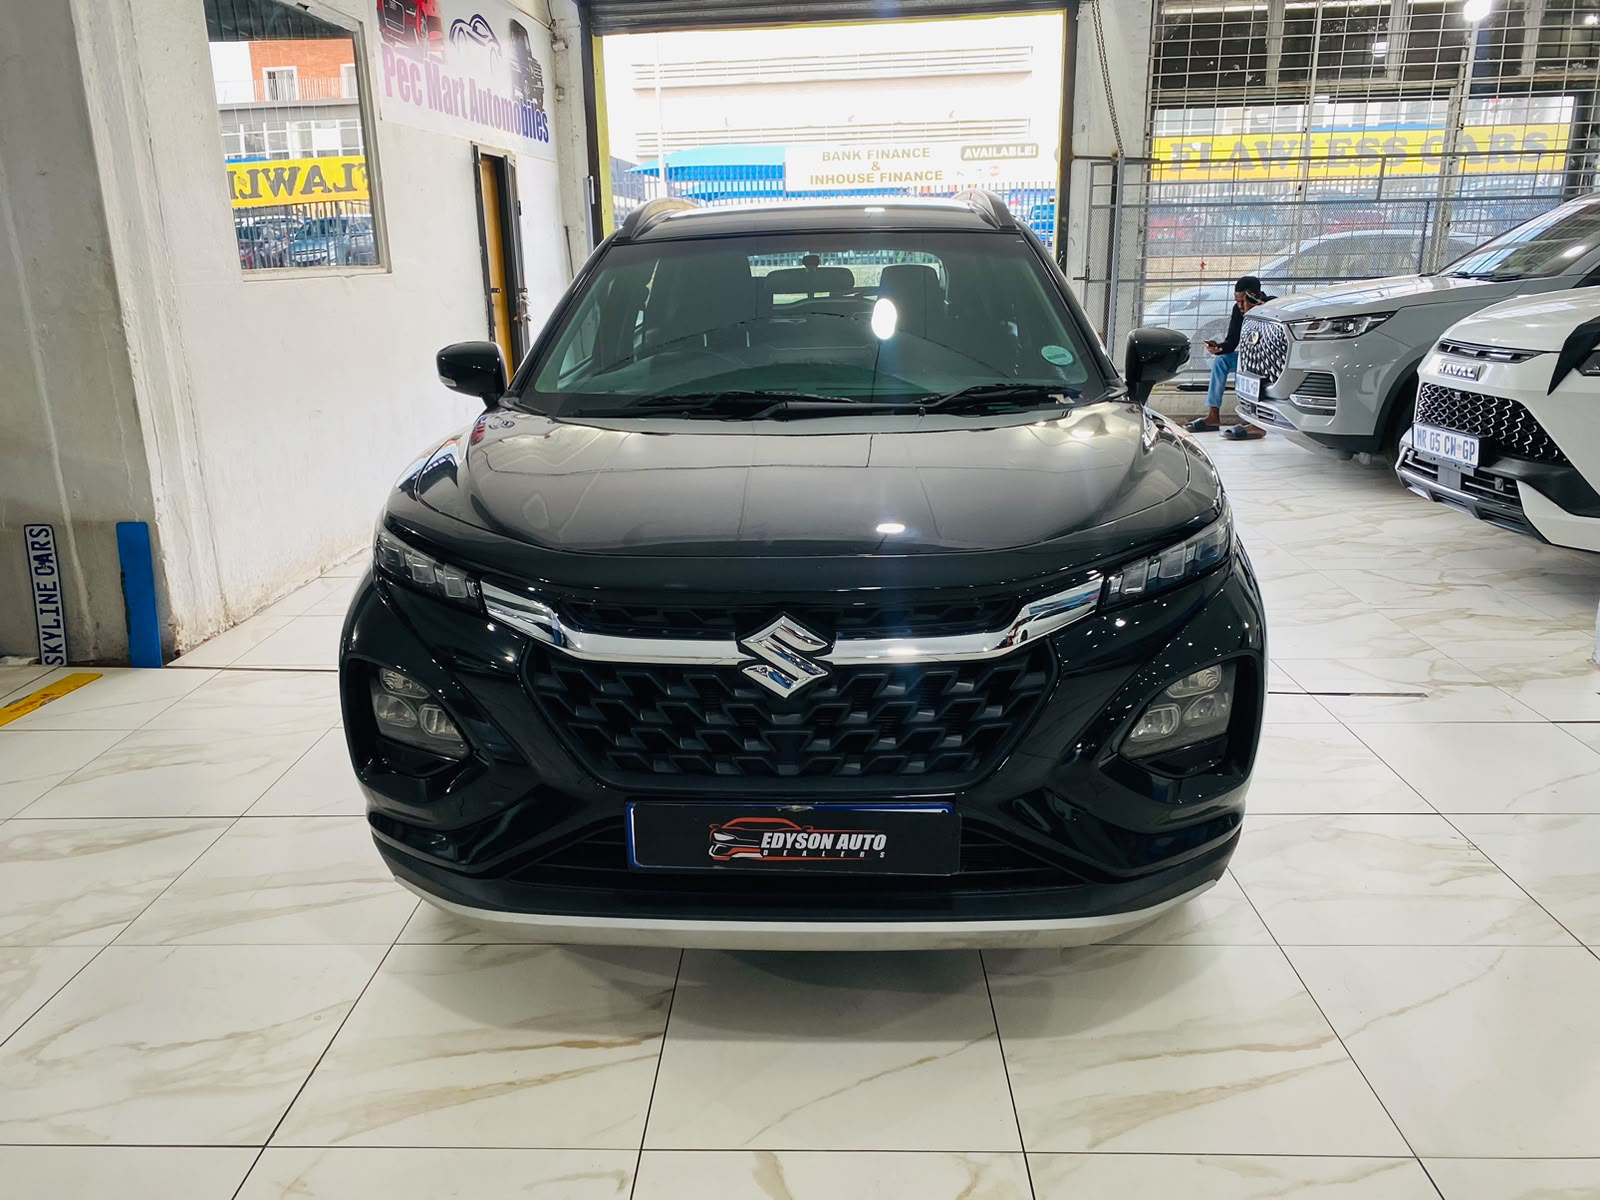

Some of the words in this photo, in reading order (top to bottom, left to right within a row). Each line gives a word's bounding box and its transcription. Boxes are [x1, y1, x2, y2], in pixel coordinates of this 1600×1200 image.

[381, 43, 424, 107] Pec
[424, 61, 468, 120] Mart
[468, 78, 549, 144] Automobiles
[822, 151, 862, 162] BANK
[867, 147, 931, 160] FINANCE
[963, 145, 1037, 159] AVAILABLE!
[871, 161, 881, 172] &
[809, 173, 875, 185] INHOUSE
[880, 170, 943, 182] FINANCE
[1439, 363, 1475, 378] HAVAL
[1429, 432, 1441, 452] 05
[1462, 440, 1476, 461] GP
[29, 528, 55, 576] CARS
[36, 581, 64, 666] SKYLINE
[761, 832, 834, 850] EDYSON
[835, 834, 887, 851] AUTO
